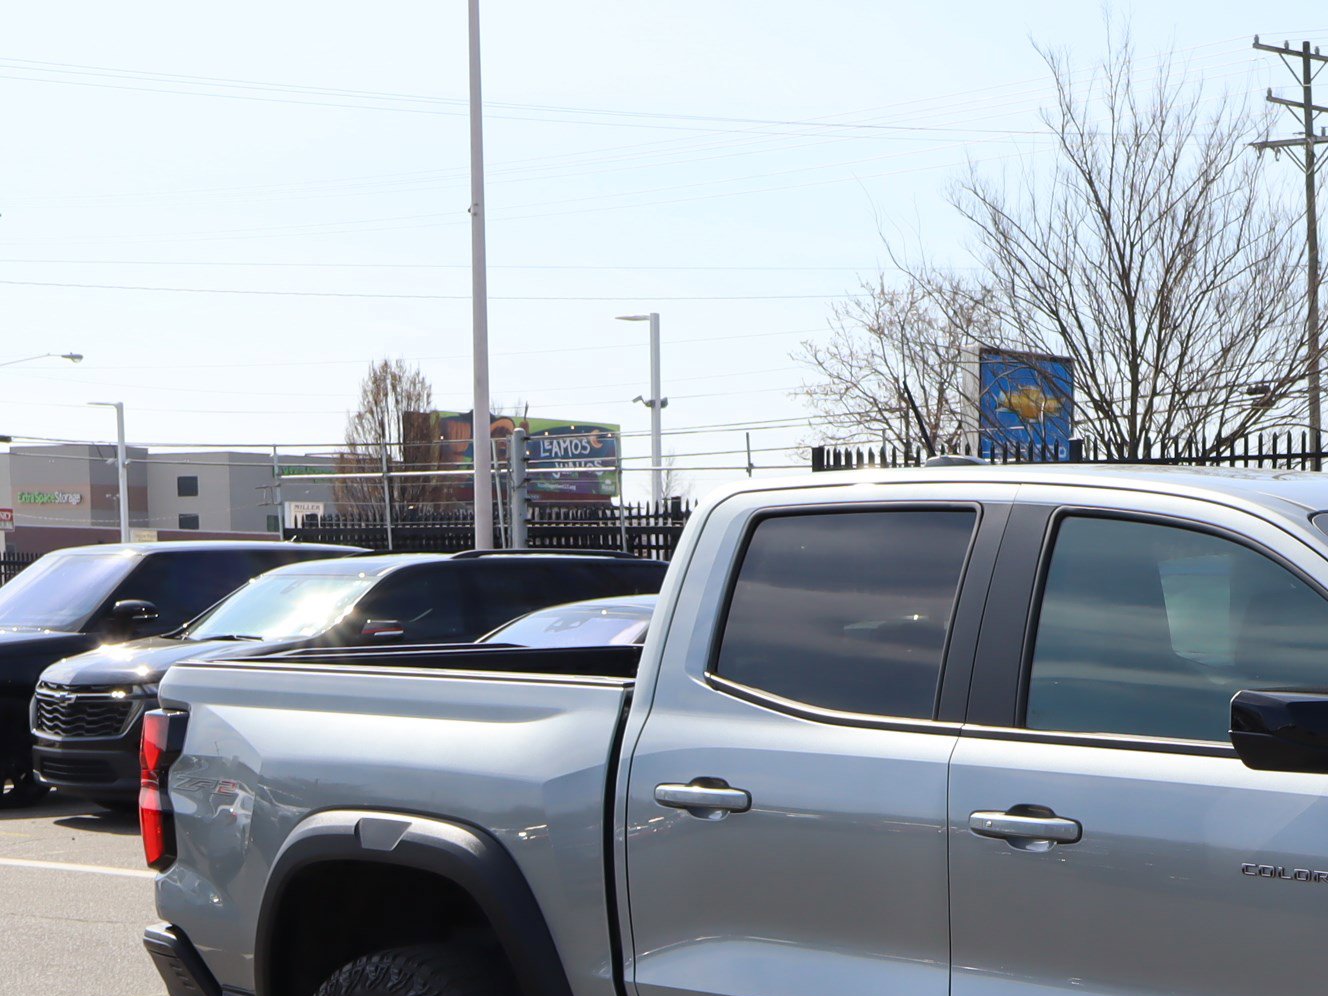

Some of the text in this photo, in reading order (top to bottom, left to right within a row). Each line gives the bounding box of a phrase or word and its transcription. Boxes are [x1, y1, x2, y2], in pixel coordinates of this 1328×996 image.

[540, 437, 591, 458] LEAMOS
[293, 503, 321, 511] MILLER
[173, 773, 239, 794] ZR2
